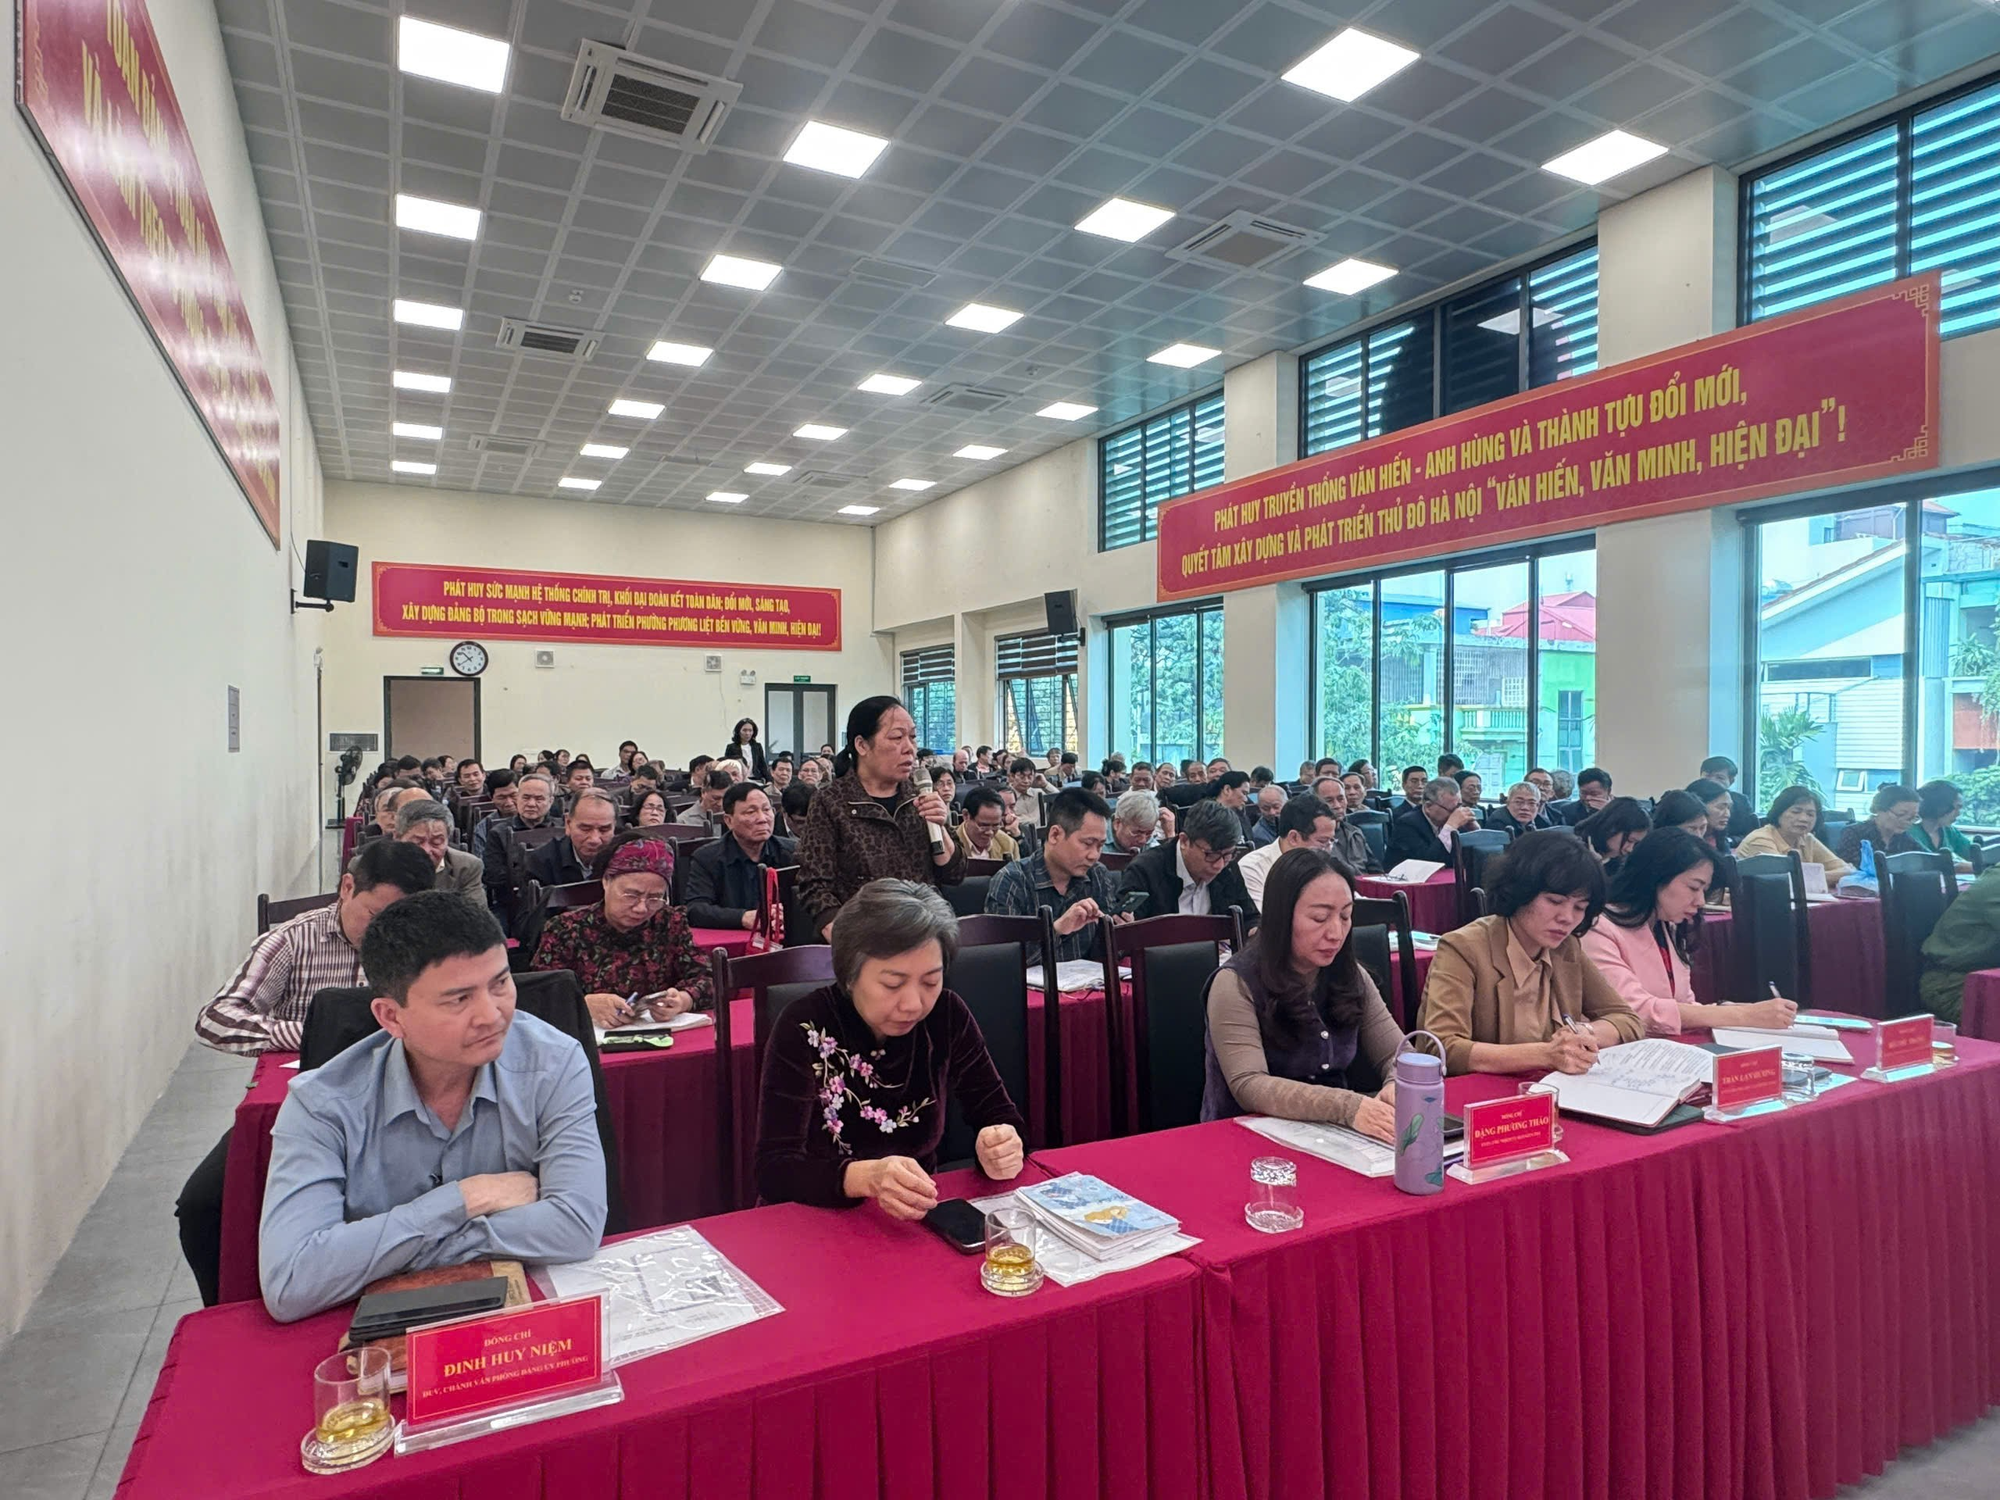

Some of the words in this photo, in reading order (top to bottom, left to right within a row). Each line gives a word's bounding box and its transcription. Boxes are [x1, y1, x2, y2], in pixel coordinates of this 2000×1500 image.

[1214, 502, 1238, 532] PHÁT
[1240, 499, 1260, 525] HUY
[1263, 481, 1304, 519] TRUYỀN
[1307, 471, 1346, 507] THỐNG
[1349, 465, 1376, 498] VĂN
[1379, 450, 1411, 491] HIẾN
[1425, 448, 1456, 479] ANH
[1460, 432, 1505, 469] HÙNG
[1510, 419, 1533, 457] VÀ
[1537, 403, 1599, 451] THÀNH
[1605, 392, 1643, 436] TỰU
[1649, 371, 1686, 424] ĐỔI
[1694, 363, 1747, 409] MỚI,
[1182, 545, 1209, 576] QUYẾT
[1211, 539, 1231, 570] TÂM
[1234, 536, 1253, 565] XÂY
[1256, 531, 1284, 565] DỰNG
[1287, 527, 1302, 553] VÀ
[1304, 519, 1335, 551] PHÁT
[1338, 503, 1374, 544] TRIỂN
[1378, 496, 1403, 535] THỦ
[1406, 501, 1426, 529] ĐÔ
[1430, 488, 1450, 524] HÀ
[1455, 486, 1482, 521] NỘI
[1535, 455, 1584, 502] HIẾN,
[1590, 450, 1630, 491] VĂN
[1637, 439, 1702, 481] MINH,
[1710, 420, 1767, 470] HIỆN
[443, 1357, 486, 1378] ĐINH
[491, 1347, 527, 1366] HUY
[530, 1338, 573, 1357] NIỆM
[514, 1328, 532, 1341] CHÍ
